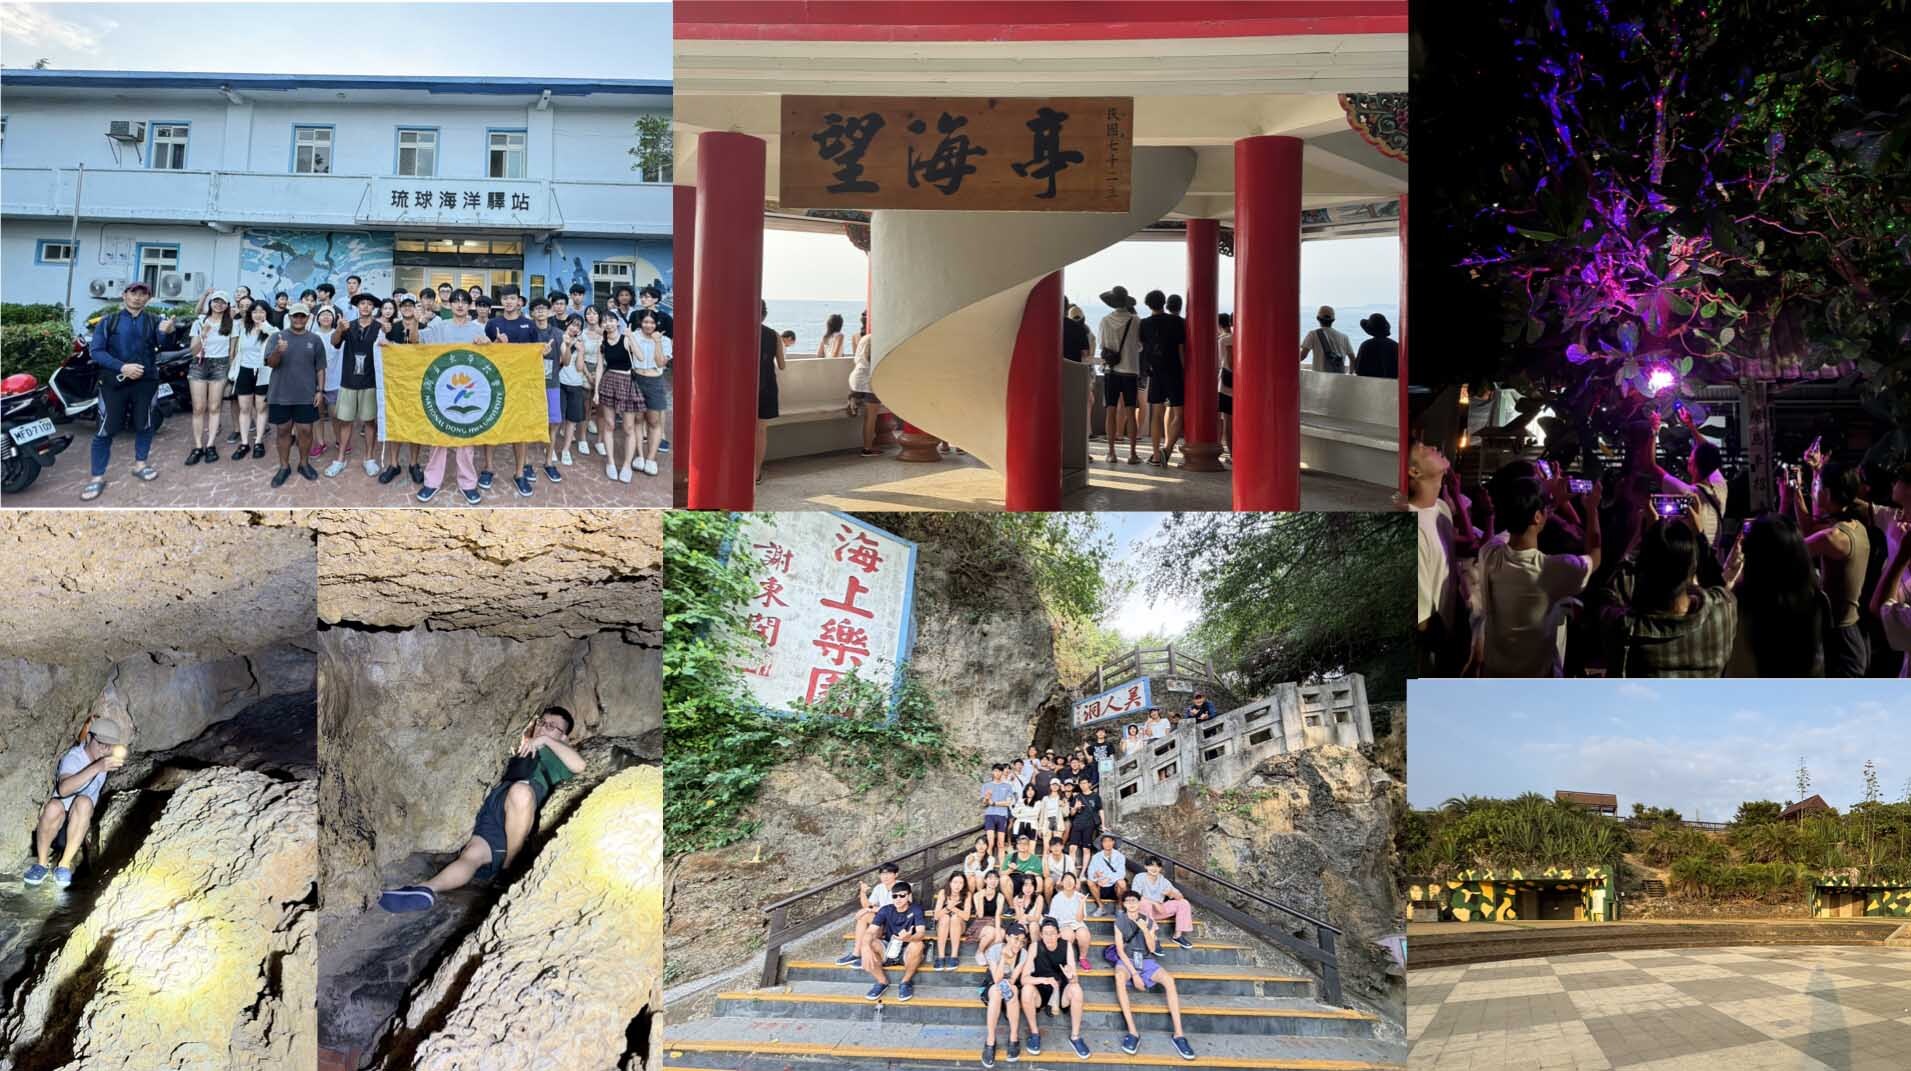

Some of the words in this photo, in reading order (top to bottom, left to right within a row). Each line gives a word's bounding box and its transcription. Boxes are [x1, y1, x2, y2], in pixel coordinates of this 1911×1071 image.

[811, 107, 1085, 200] 望海亭
[391, 189, 530, 211] 琉球海洋驛站
[424, 394, 445, 428] NATIONAL
[445, 423, 467, 433] DONG
